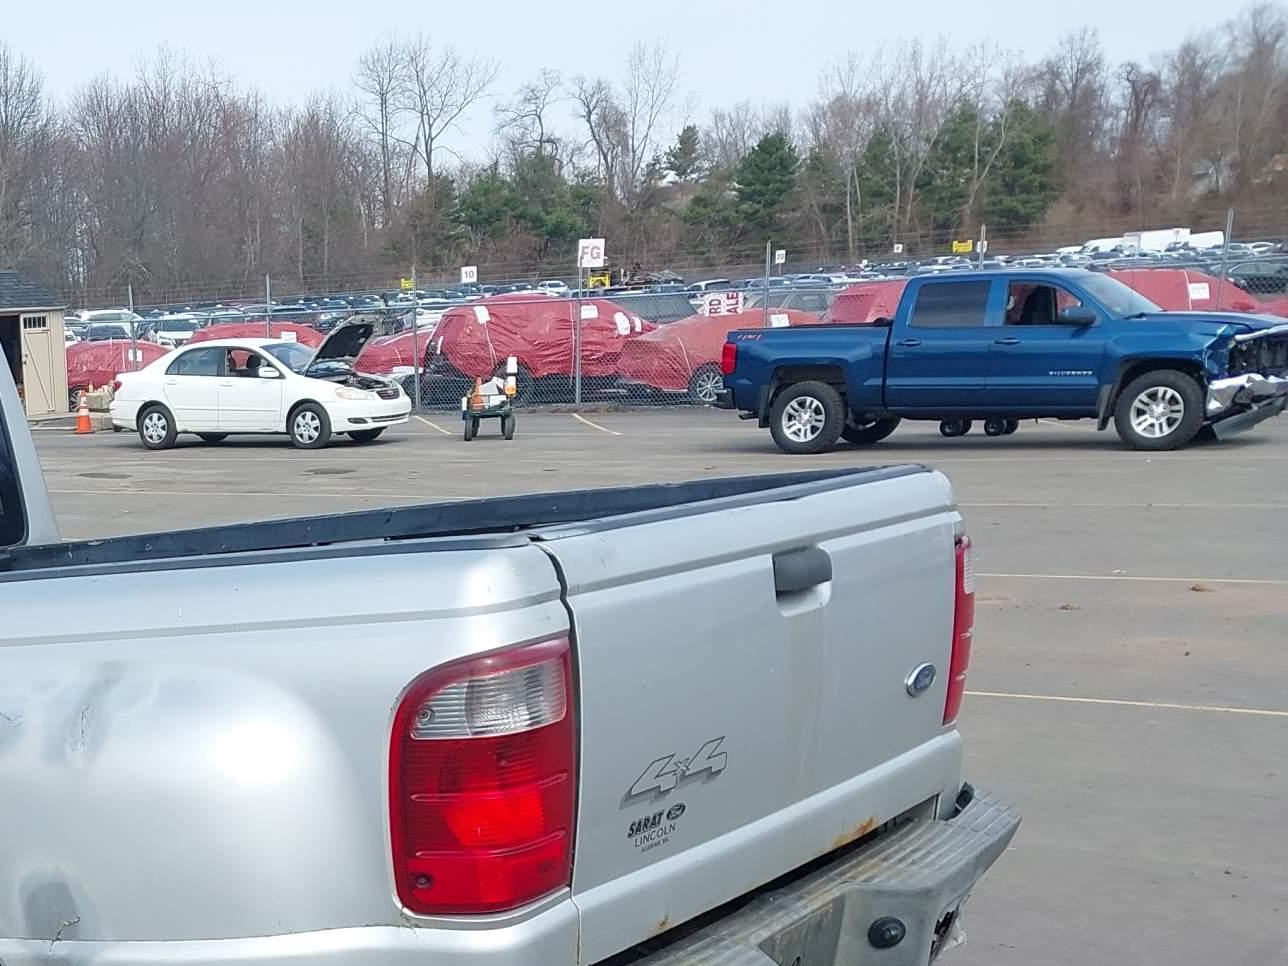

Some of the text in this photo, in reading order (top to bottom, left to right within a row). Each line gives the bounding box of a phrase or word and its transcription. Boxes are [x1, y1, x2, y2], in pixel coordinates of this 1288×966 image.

[580, 245, 601, 260] FG
[464, 270, 475, 279] 10
[627, 810, 665, 838] SARAT
[634, 823, 676, 848] LINCOLN
